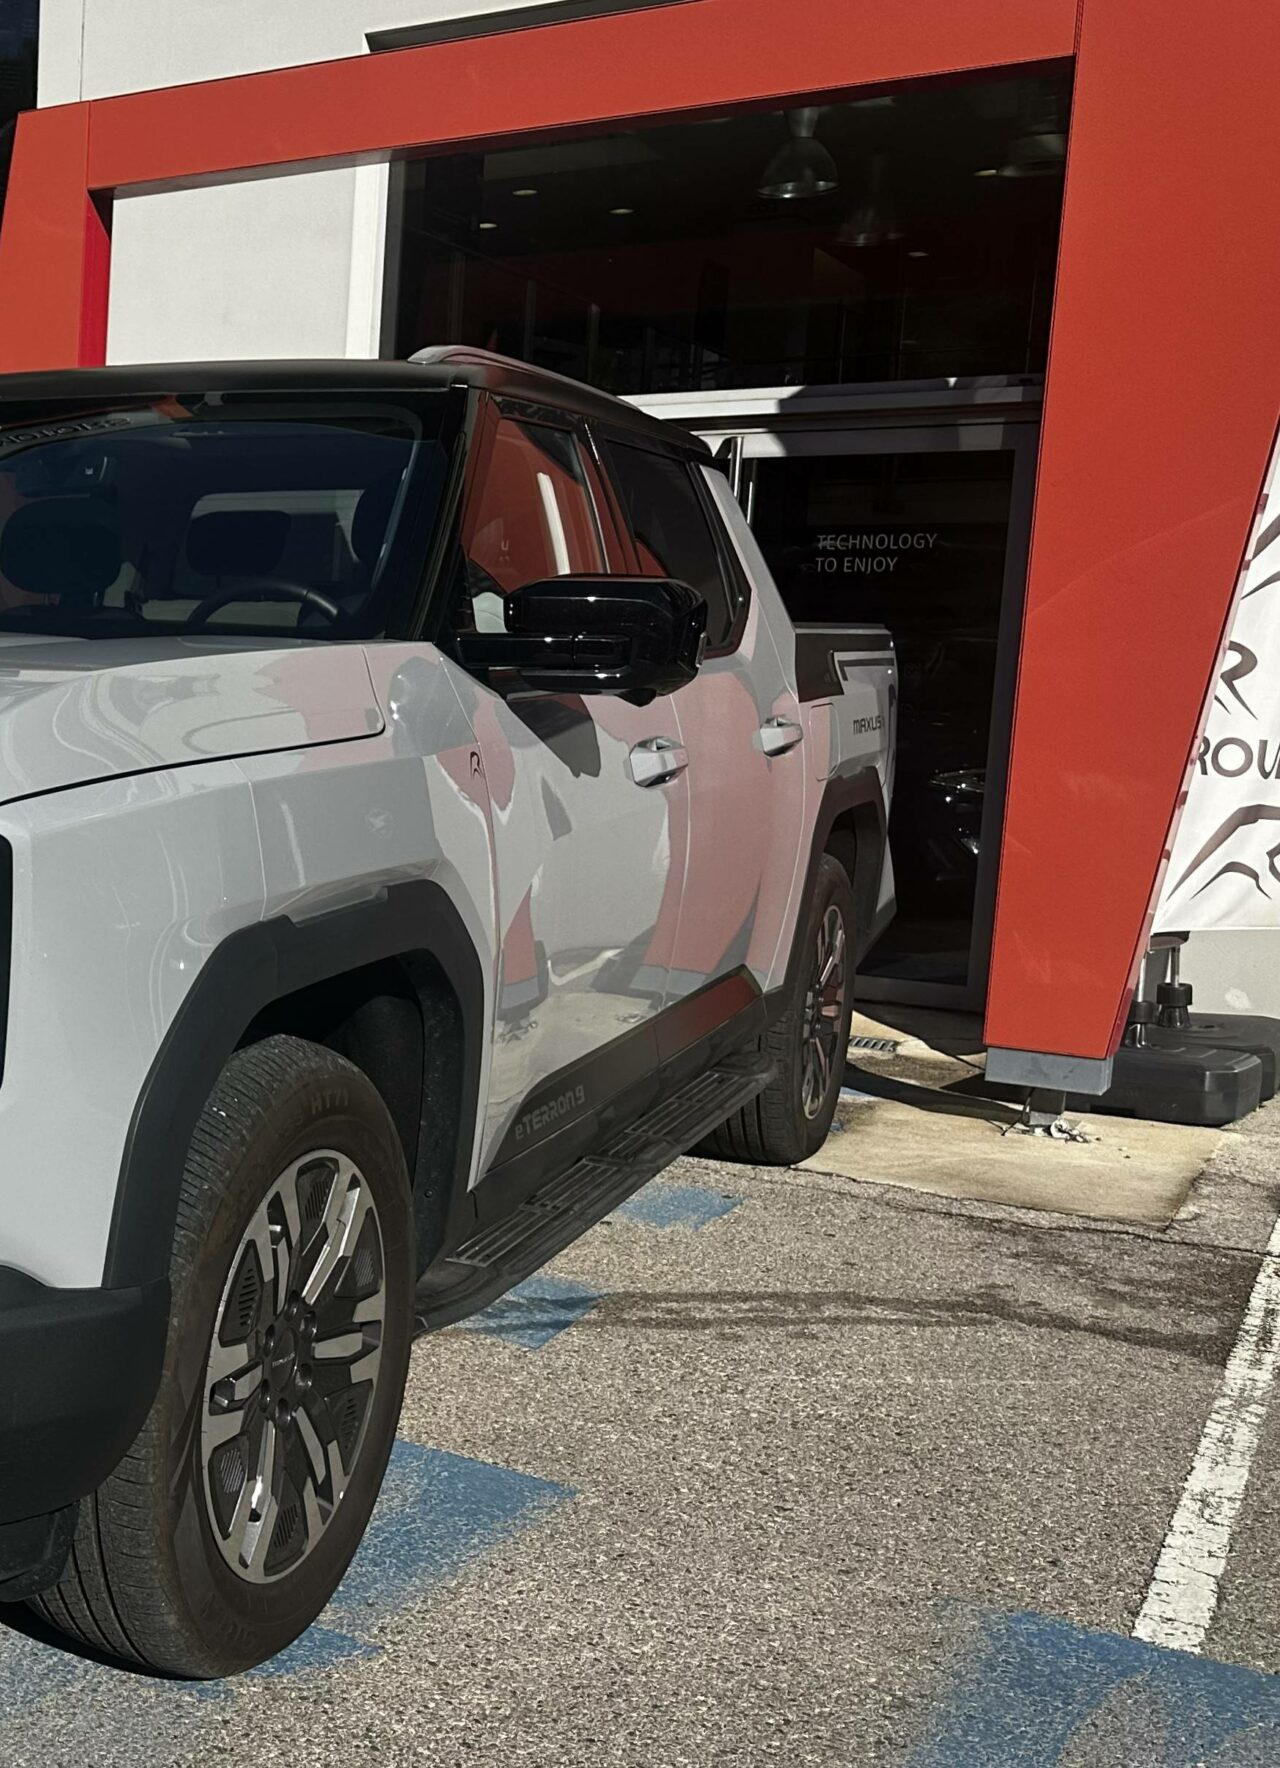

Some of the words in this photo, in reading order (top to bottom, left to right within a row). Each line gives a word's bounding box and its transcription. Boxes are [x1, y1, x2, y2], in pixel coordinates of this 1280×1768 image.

[817, 533, 938, 550] TECHNOLOGY
[816, 557, 837, 573] TO
[843, 556, 898, 574] ENJOY
